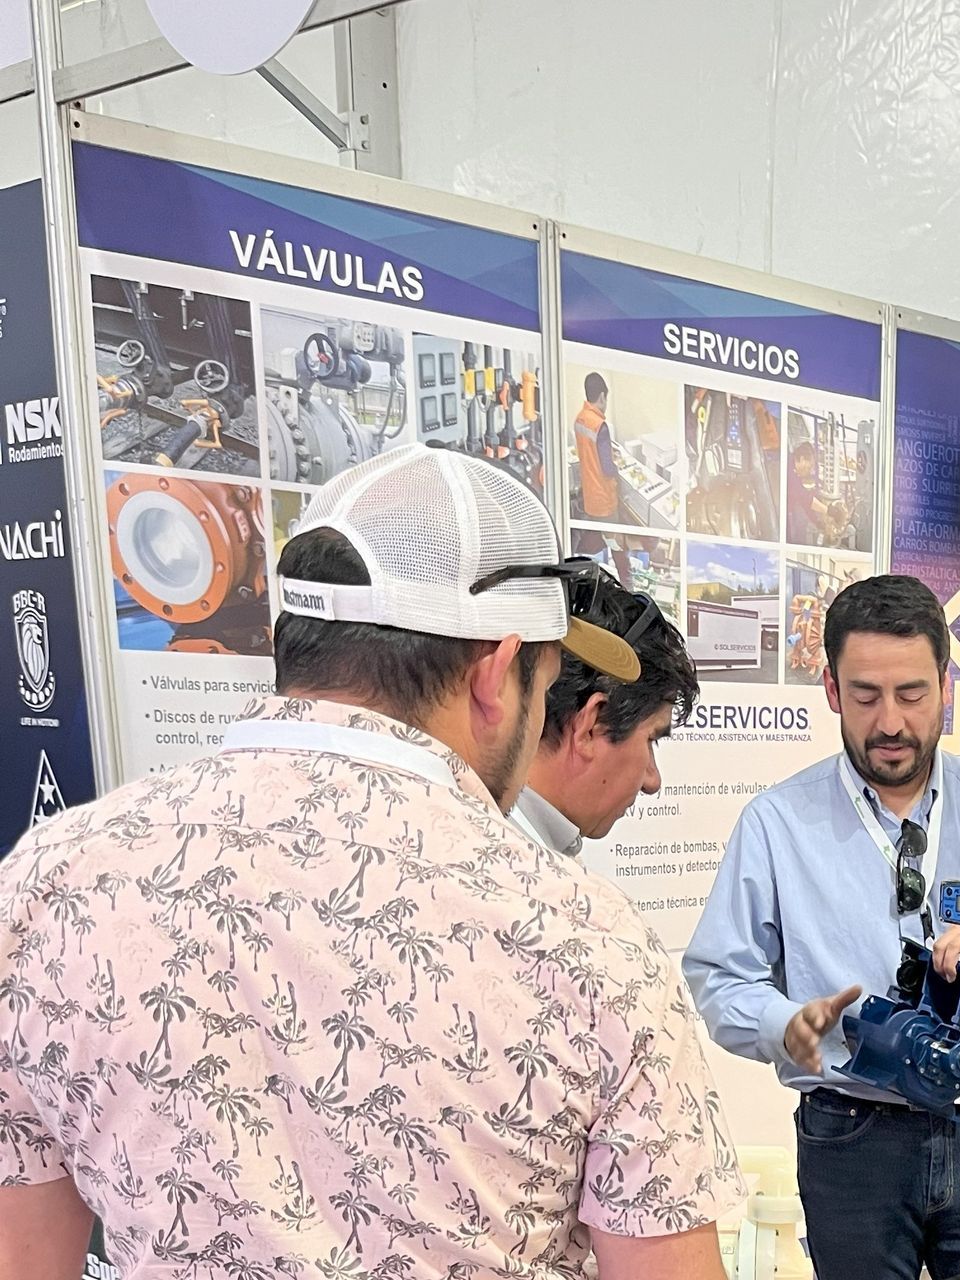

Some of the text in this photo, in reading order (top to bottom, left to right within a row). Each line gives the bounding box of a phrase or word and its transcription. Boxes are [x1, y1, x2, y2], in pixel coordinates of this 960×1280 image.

[229, 229, 424, 301] VÁLVULAS
[663, 322, 800, 379] SERVICIOS
[5, 397, 62, 444] NSK
[150, 675, 201, 690] Válvulas
[204, 681, 230, 694] para
[154, 709, 196, 724] Discos
[200, 711, 215, 724] de
[155, 731, 203, 746] control,
[718, 733, 760, 742] ASISTENCIA
[765, 734, 812, 742] MAESTRANZA
[664, 783, 716, 796] mantención
[718, 783, 729, 795] de
[638, 807, 645, 820] y
[647, 803, 682, 817] control.
[615, 841, 720, 859] Reparación de bombas,
[615, 862, 677, 877] instrumentos
[678, 865, 684, 876] y
[667, 896, 698, 909] técnica
